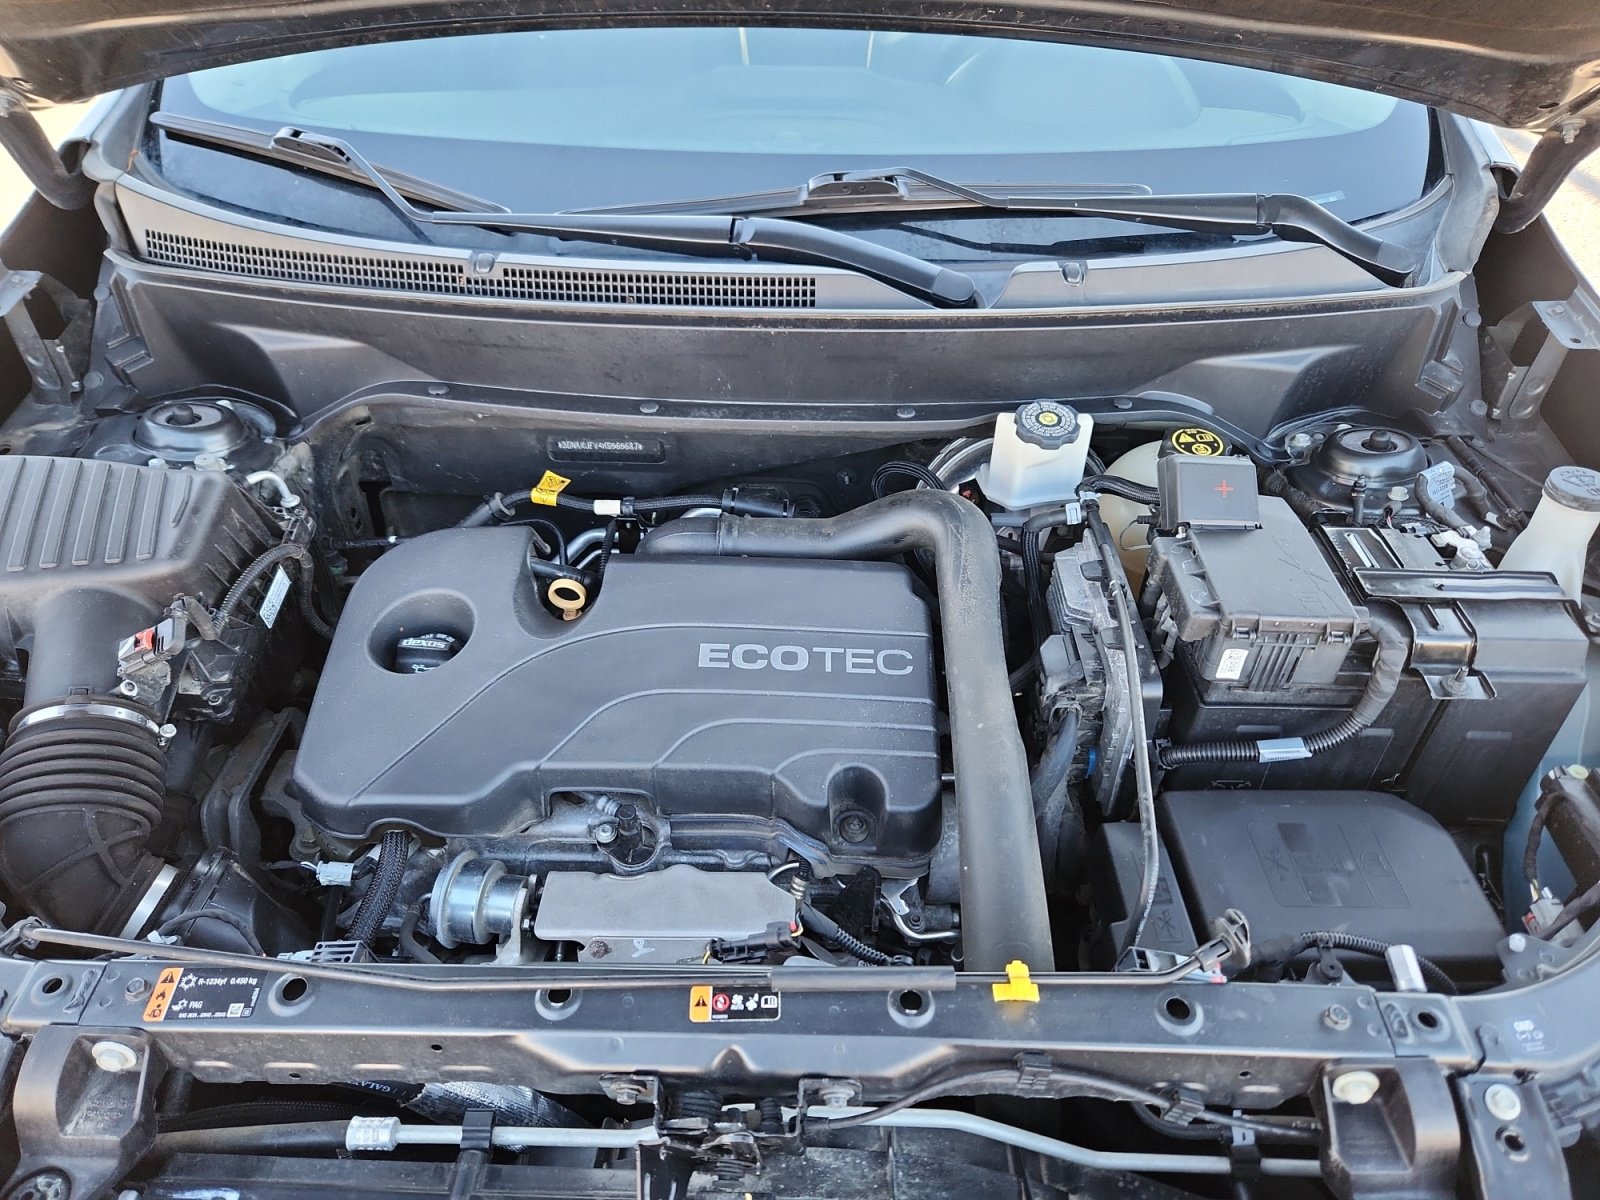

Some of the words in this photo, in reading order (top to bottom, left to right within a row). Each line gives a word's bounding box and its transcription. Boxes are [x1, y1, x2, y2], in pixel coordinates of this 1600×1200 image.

[402, 638, 447, 649] dexos
[698, 643, 914, 675] ECOTEC
[189, 1001, 203, 1009] PAG
